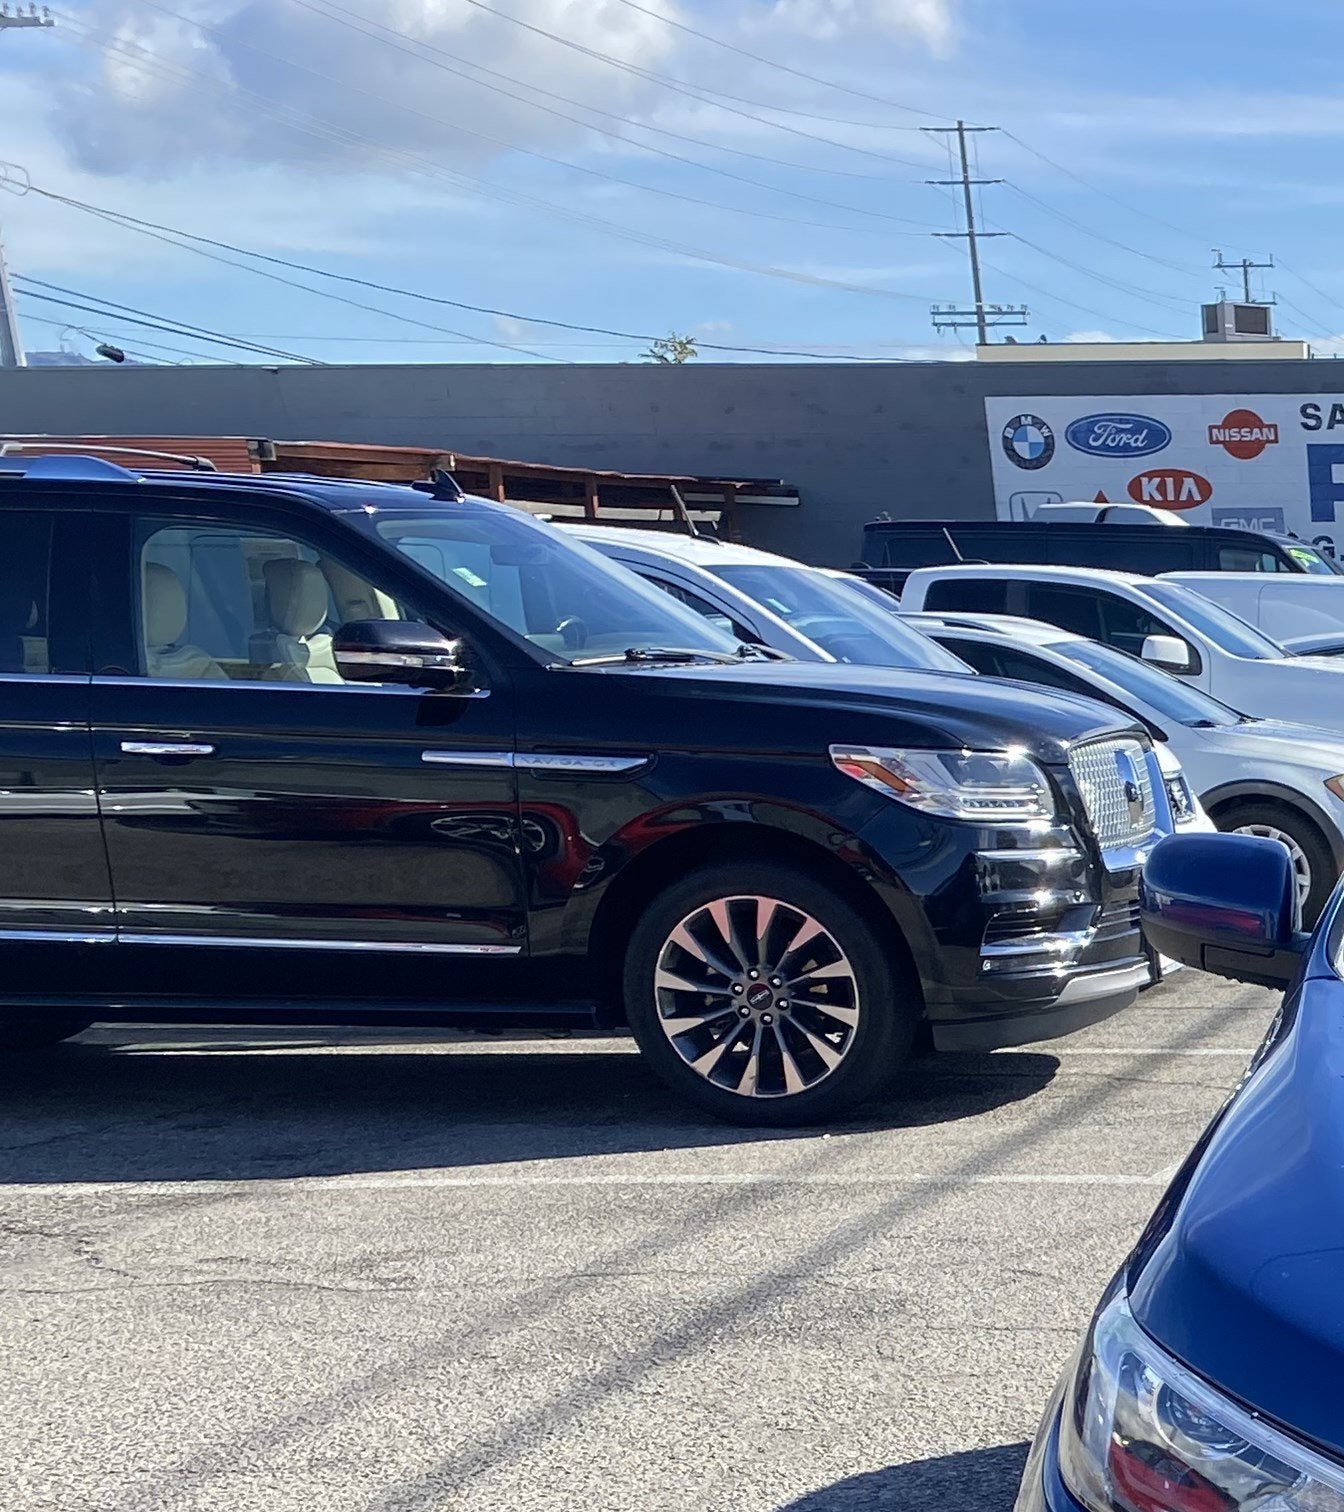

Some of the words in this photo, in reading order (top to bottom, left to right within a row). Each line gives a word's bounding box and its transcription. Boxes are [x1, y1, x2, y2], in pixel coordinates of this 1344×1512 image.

[1088, 414, 1149, 449] Ford
[1211, 426, 1277, 442] NISSAN
[1139, 476, 1203, 502] KIA
